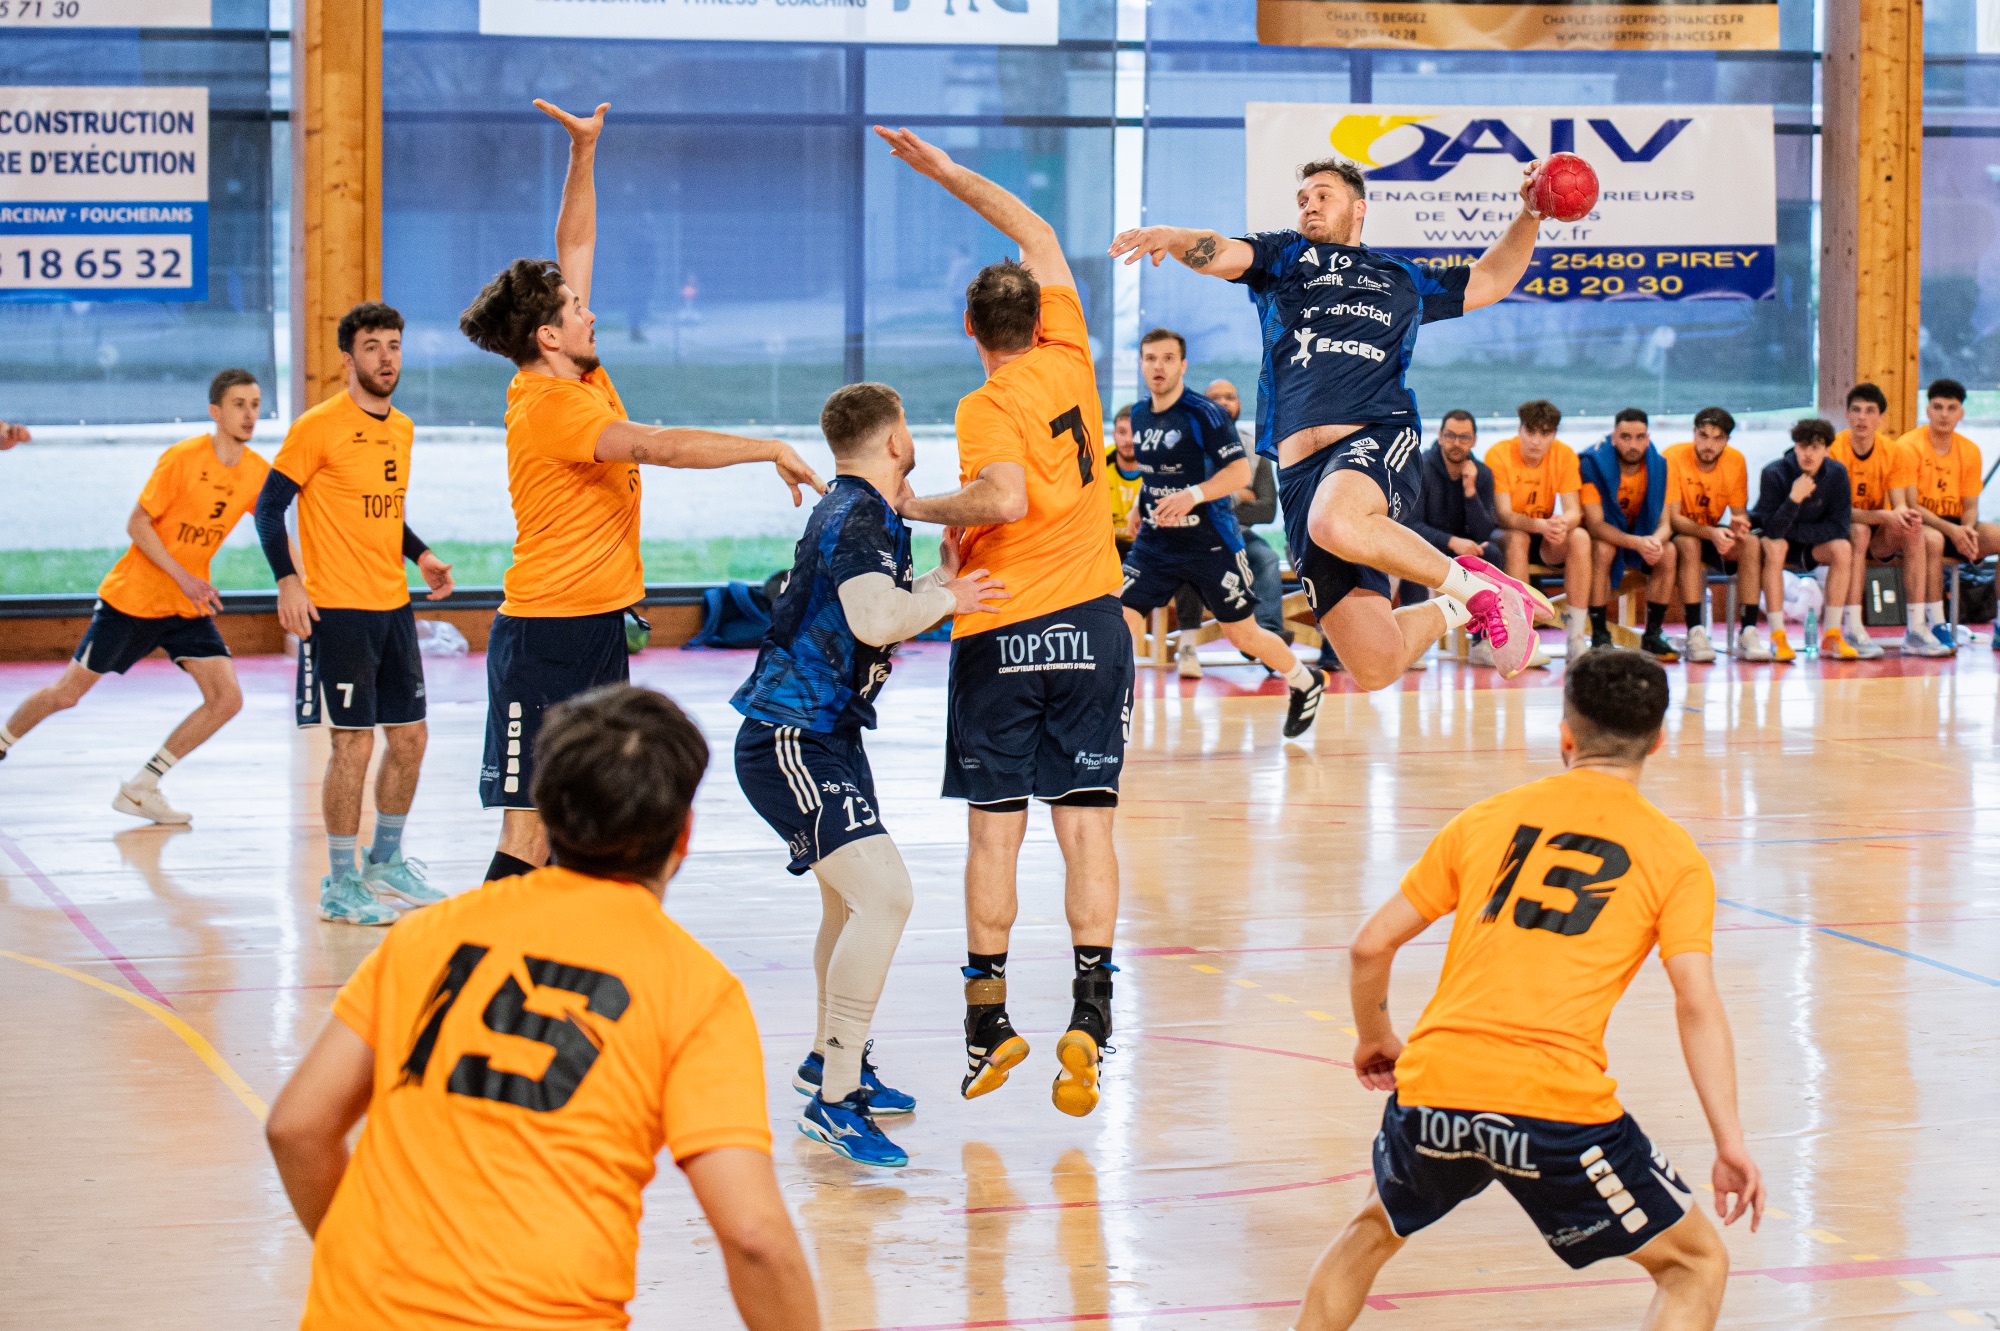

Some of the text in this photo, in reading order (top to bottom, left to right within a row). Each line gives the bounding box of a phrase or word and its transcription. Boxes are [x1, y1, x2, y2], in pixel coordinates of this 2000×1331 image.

[18, 0, 42, 18] 71
[52, 0, 80, 18] 30
[1382, 12, 1426, 24] BERGEZ
[0, 110, 194, 135] CONSTRUCTION
[1368, 190, 1521, 202] ENAGEMENT
[1603, 189, 1696, 202] RIEURS
[0, 207, 193, 223] RCENAY FOUCHERANS
[1415, 211, 1446, 222] DE
[17, 248, 182, 279] 18 65 32
[1328, 251, 1353, 273] 19
[1551, 252, 1646, 270] 25480
[1656, 251, 1760, 268] PIREY
[1524, 274, 1684, 296] 48 20 30
[1325, 302, 1392, 327] andstad
[1048, 404, 1095, 488] 7
[1140, 428, 1164, 452] 24
[383, 460, 397, 482] 2
[209, 501, 227, 519] 3
[996, 629, 1095, 665] TOPSTYL
[998, 664, 1034, 675] CONCEPTEUR
[336, 683, 355, 709] 7
[842, 796, 876, 832] 13
[1479, 823, 1632, 937] 13
[391, 942, 631, 1113] 15
[1417, 1106, 1538, 1170] TOPSTYL
